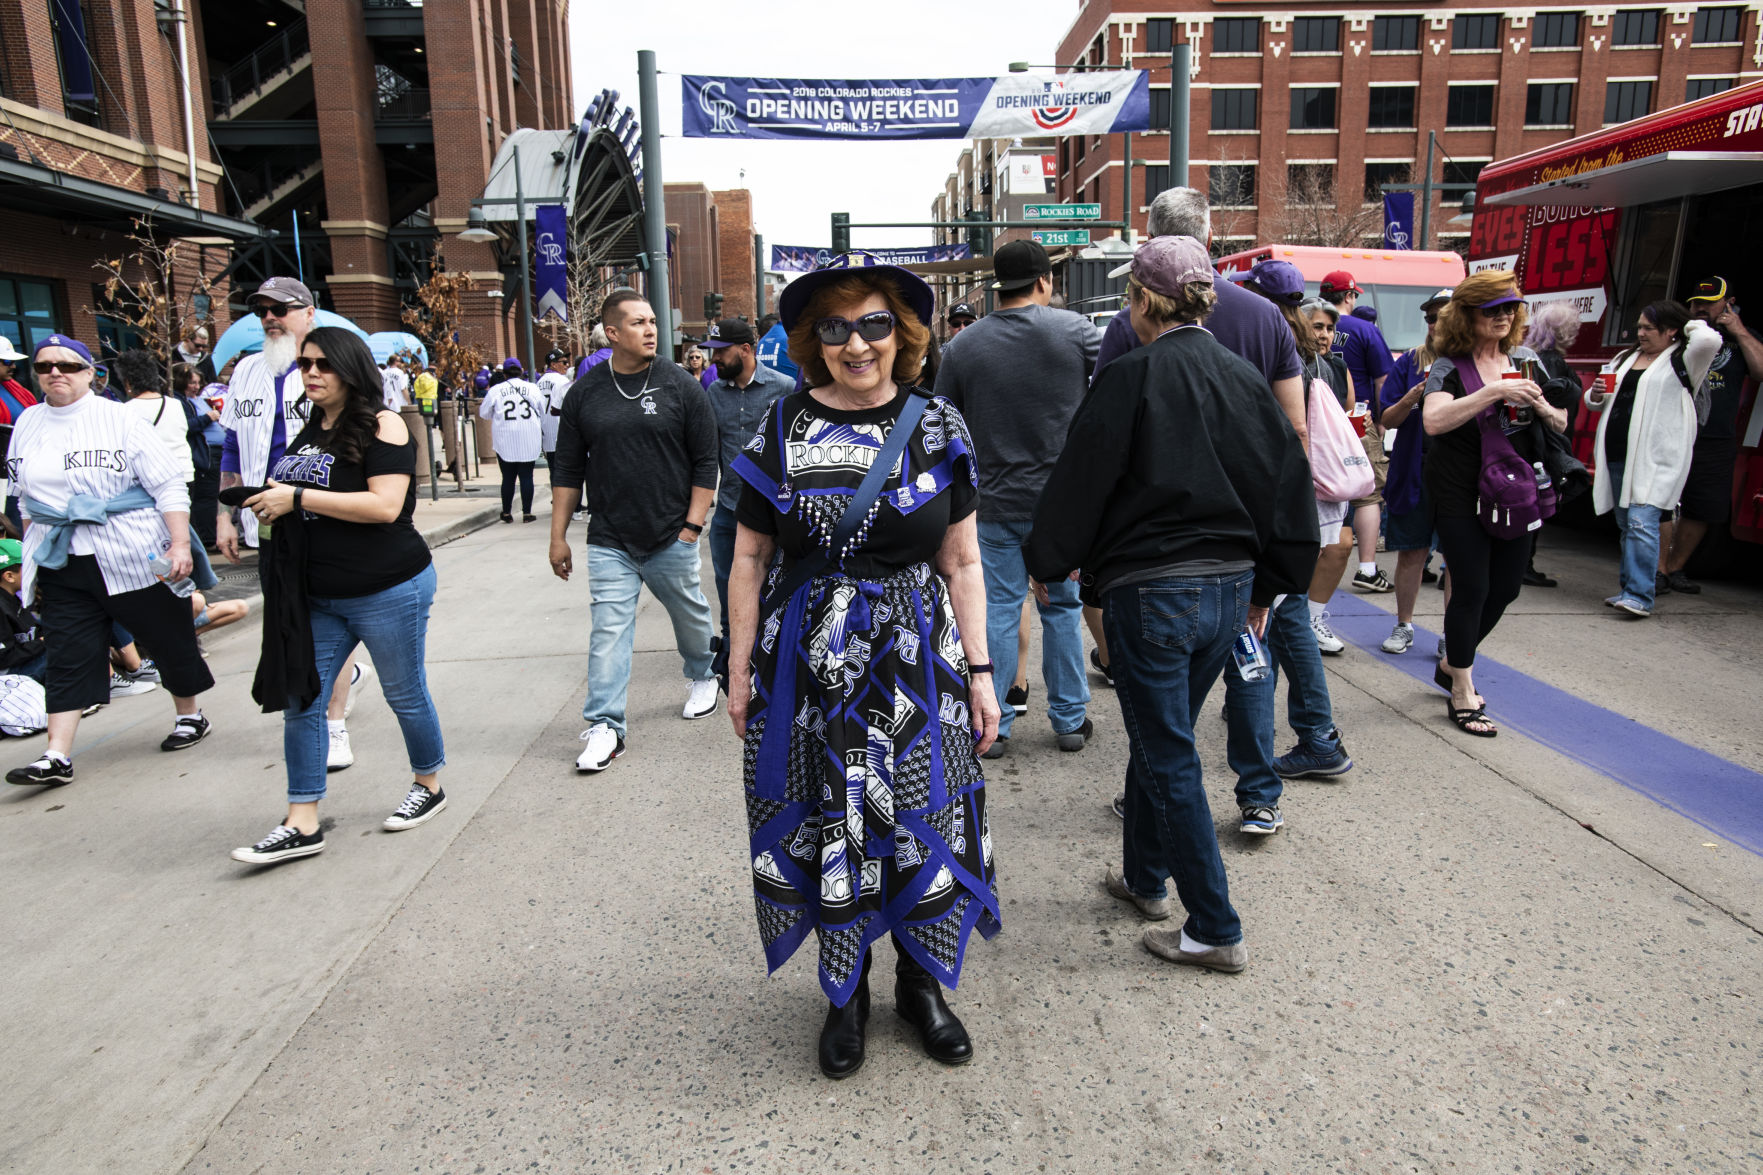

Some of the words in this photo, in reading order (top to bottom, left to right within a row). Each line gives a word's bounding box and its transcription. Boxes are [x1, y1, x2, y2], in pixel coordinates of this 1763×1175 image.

[793, 87, 816, 97] 2019
[818, 87, 868, 97] COLORADO
[871, 87, 912, 97] ROCKIES
[996, 94, 1050, 108] OPENING
[1053, 91, 1112, 106] WEEKEND
[746, 99, 844, 119] OPENING
[849, 99, 959, 119] WEEKEND
[825, 122, 858, 132] APRIL
[860, 122, 881, 132] 5-7
[1723, 103, 1763, 138] STA
[1539, 157, 1579, 184] Started
[1576, 155, 1604, 175] from
[1605, 145, 1624, 167] the
[1041, 207, 1075, 217] ROCKIES
[1076, 206, 1099, 217] ROAD
[1046, 232, 1068, 244] 21st
[1470, 205, 1528, 255] EYES
[1525, 213, 1615, 290] LESS
[500, 386, 530, 398] GIAMBI
[504, 399, 532, 421] 23
[544, 394, 551, 415] 7
[64, 449, 128, 473] KIES
